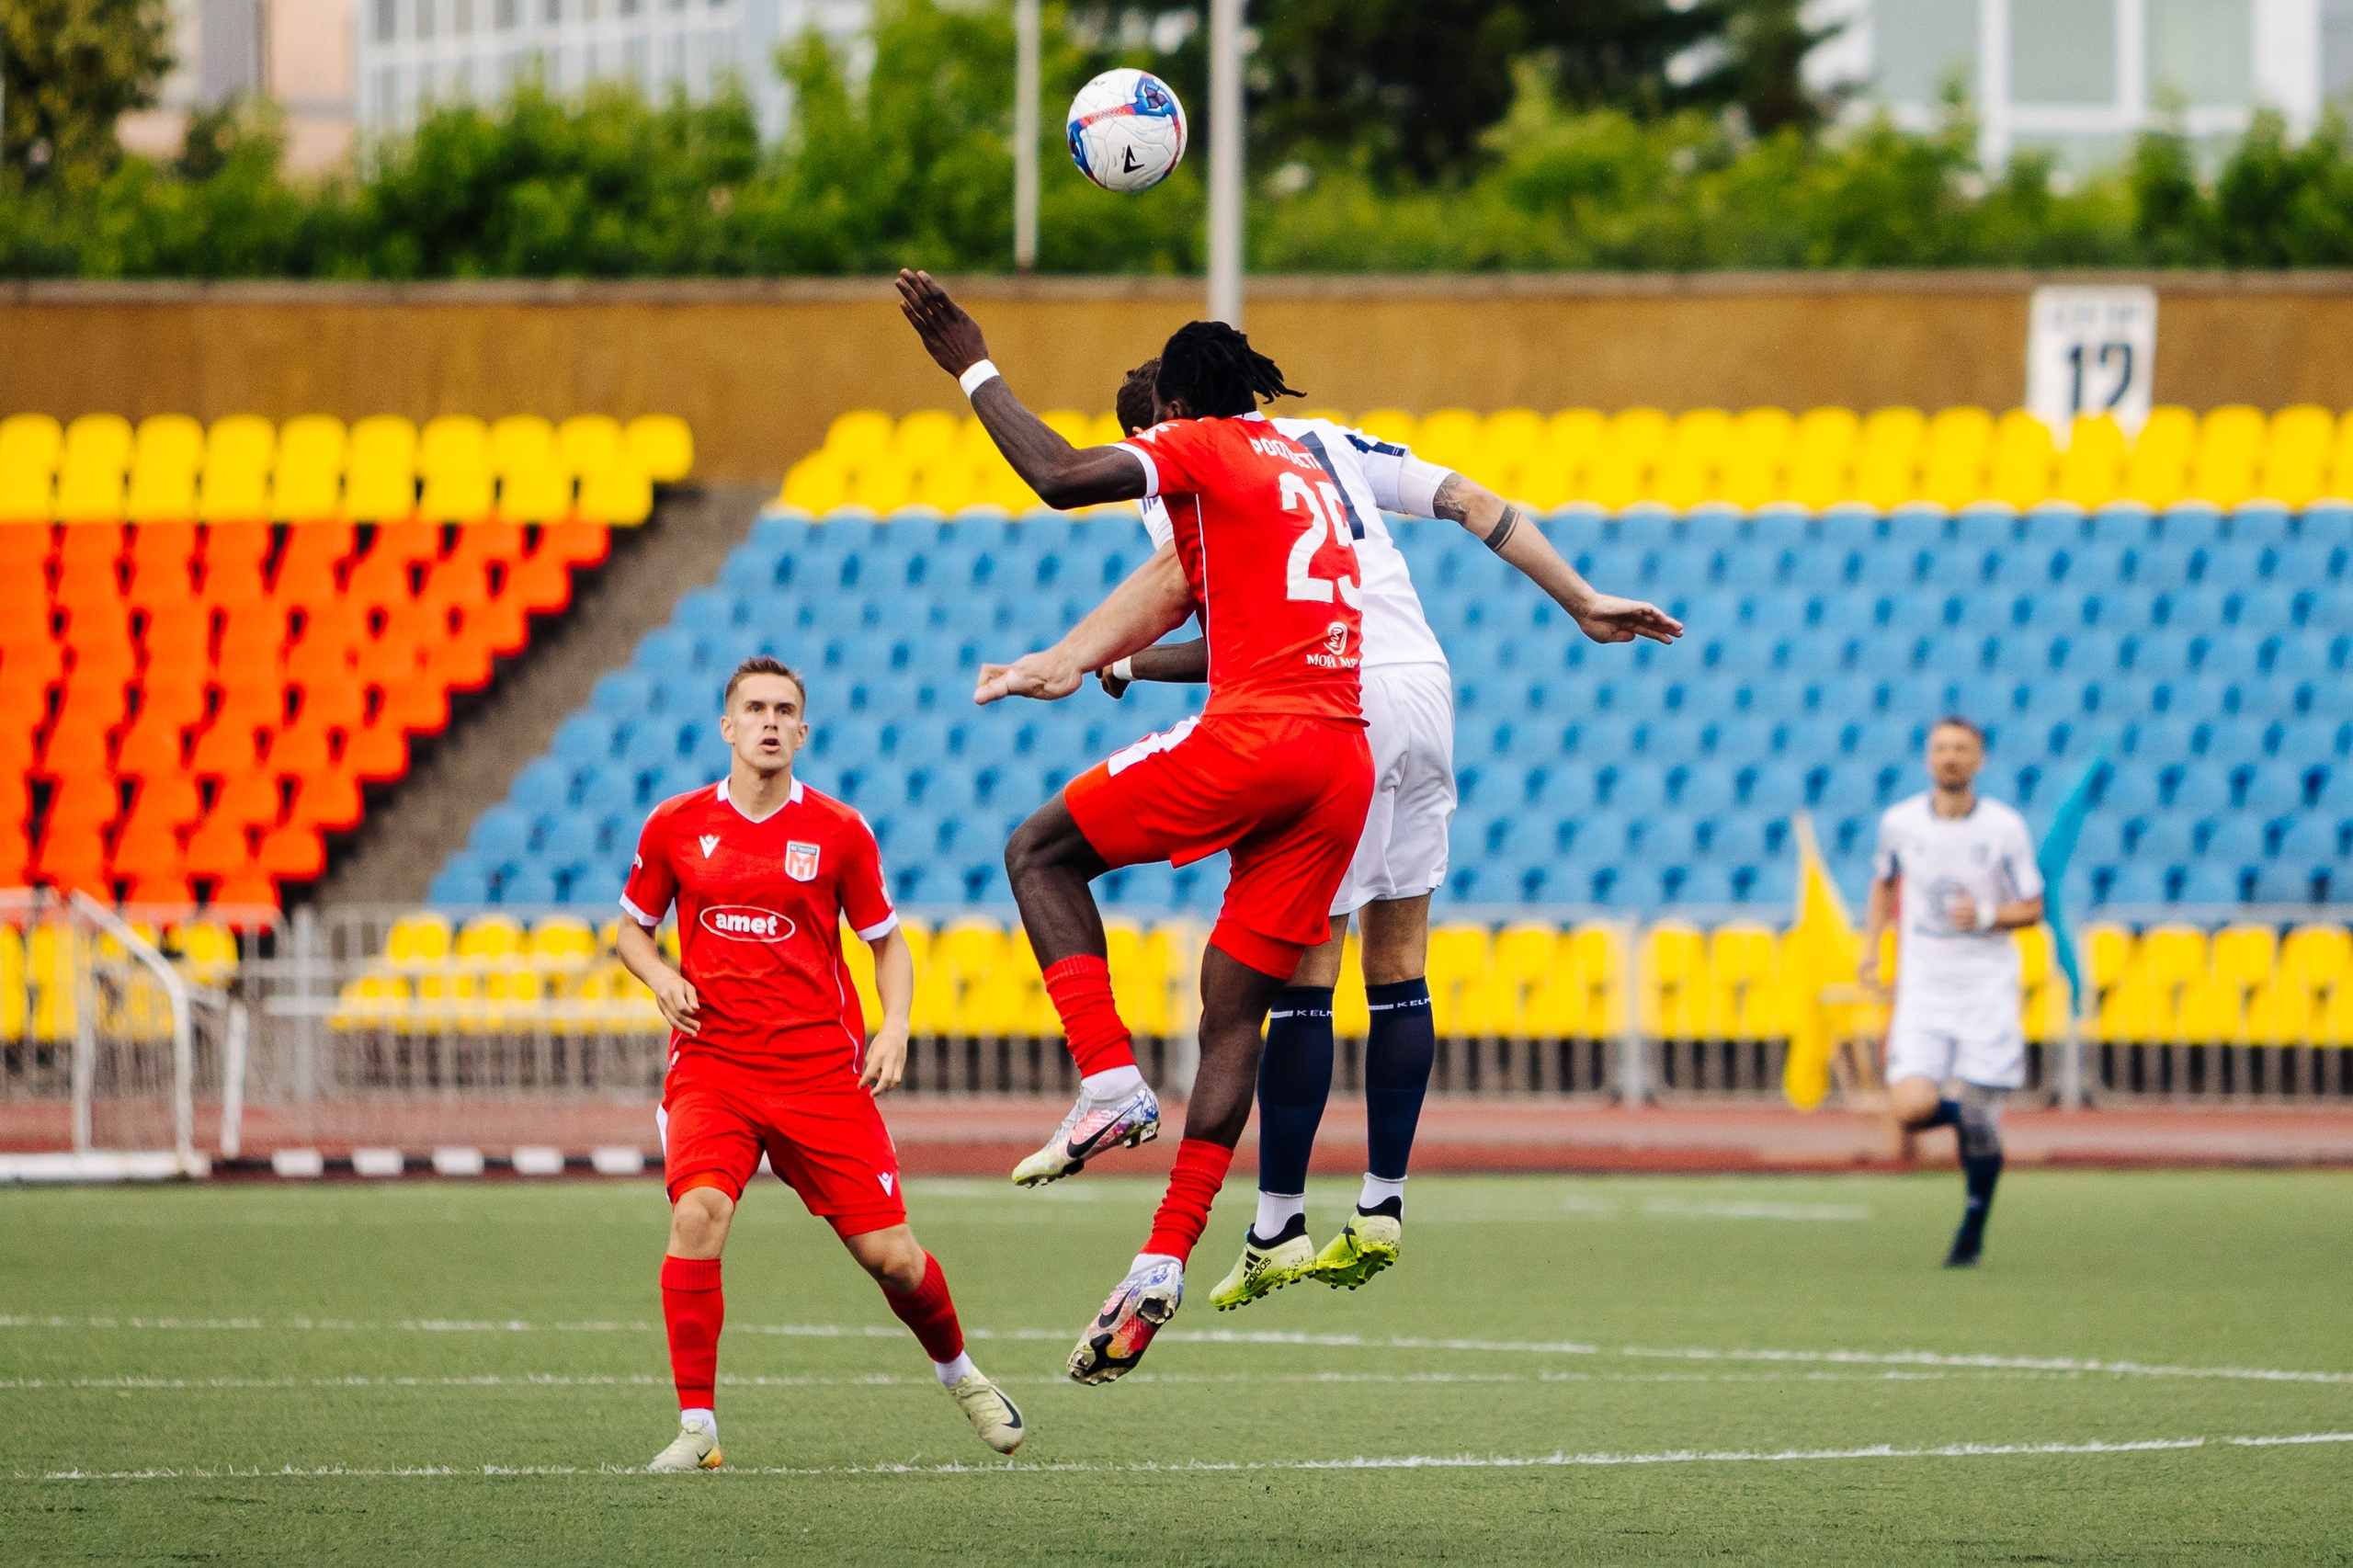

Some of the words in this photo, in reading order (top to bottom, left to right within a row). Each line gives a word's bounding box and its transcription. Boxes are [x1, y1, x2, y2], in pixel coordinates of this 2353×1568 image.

[1306, 653, 1337, 668] МОЙ
[1338, 656, 1359, 669] МЯ
[715, 913, 778, 937] amet
[1245, 1256, 1272, 1289] adidas
